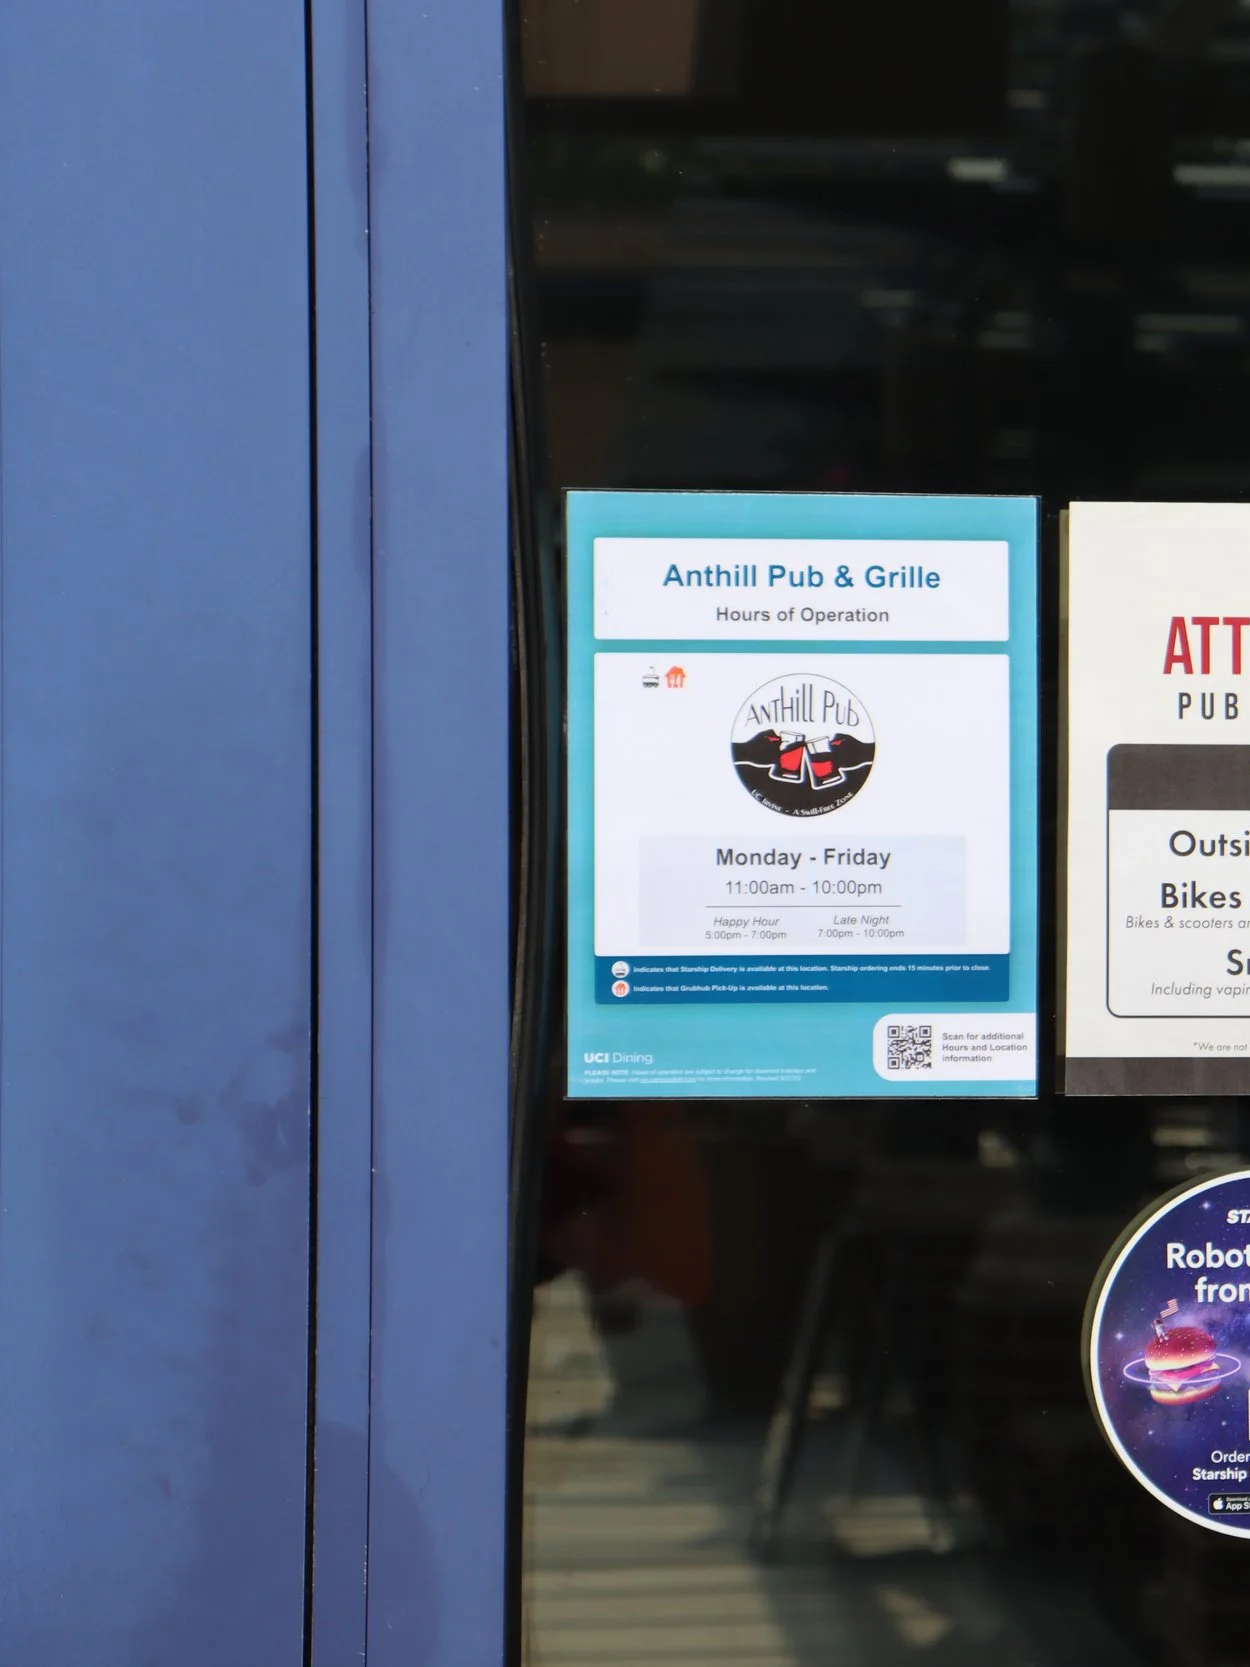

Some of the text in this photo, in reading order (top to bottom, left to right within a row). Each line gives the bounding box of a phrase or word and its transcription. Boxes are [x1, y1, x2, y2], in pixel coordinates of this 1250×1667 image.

[663, 564, 940, 588] Anthill Pub & Grille
[717, 607, 889, 625] Hours of Operation
[1179, 692, 1238, 720] PUB
[717, 849, 802, 870] Monday
[824, 848, 891, 869] Friday
[726, 880, 794, 894] 11:00am
[813, 880, 882, 897] 10:00pm
[1162, 881, 1241, 909] Bikes
[714, 917, 780, 928] Happy Hour
[834, 915, 890, 927] Late Night
[1126, 915, 1159, 928] Bikes
[1164, 916, 1174, 928] &
[1179, 918, 1233, 928] scooters
[706, 930, 741, 940] 5:00pm
[752, 930, 787, 940] 7:00pm
[818, 929, 853, 939] 7:00pm
[864, 929, 904, 939] 10:00pm
[665, 965, 678, 973] that
[680, 965, 708, 974] Starship
[710, 965, 737, 974] Delivery
[747, 965, 777, 973] available
[786, 965, 798, 973] this
[800, 965, 829, 973] location.
[830, 965, 858, 974] Starship
[860, 964, 888, 973] ordering
[889, 964, 906, 972] ends
[917, 964, 944, 972] minutes
[945, 964, 961, 973] prior
[971, 964, 990, 972] close.
[665, 984, 679, 992] that
[712, 984, 738, 992] Pick-Up
[747, 984, 777, 992] available
[786, 984, 799, 992] this
[800, 984, 829, 992] location.
[1152, 982, 1212, 999] Including
[981, 1032, 1024, 1040] additional
[584, 1053, 653, 1064] UCI Dining
[1211, 1450, 1250, 1463] Order
[1192, 1467, 1247, 1482] Starship
[1225, 1502, 1243, 1511] App
